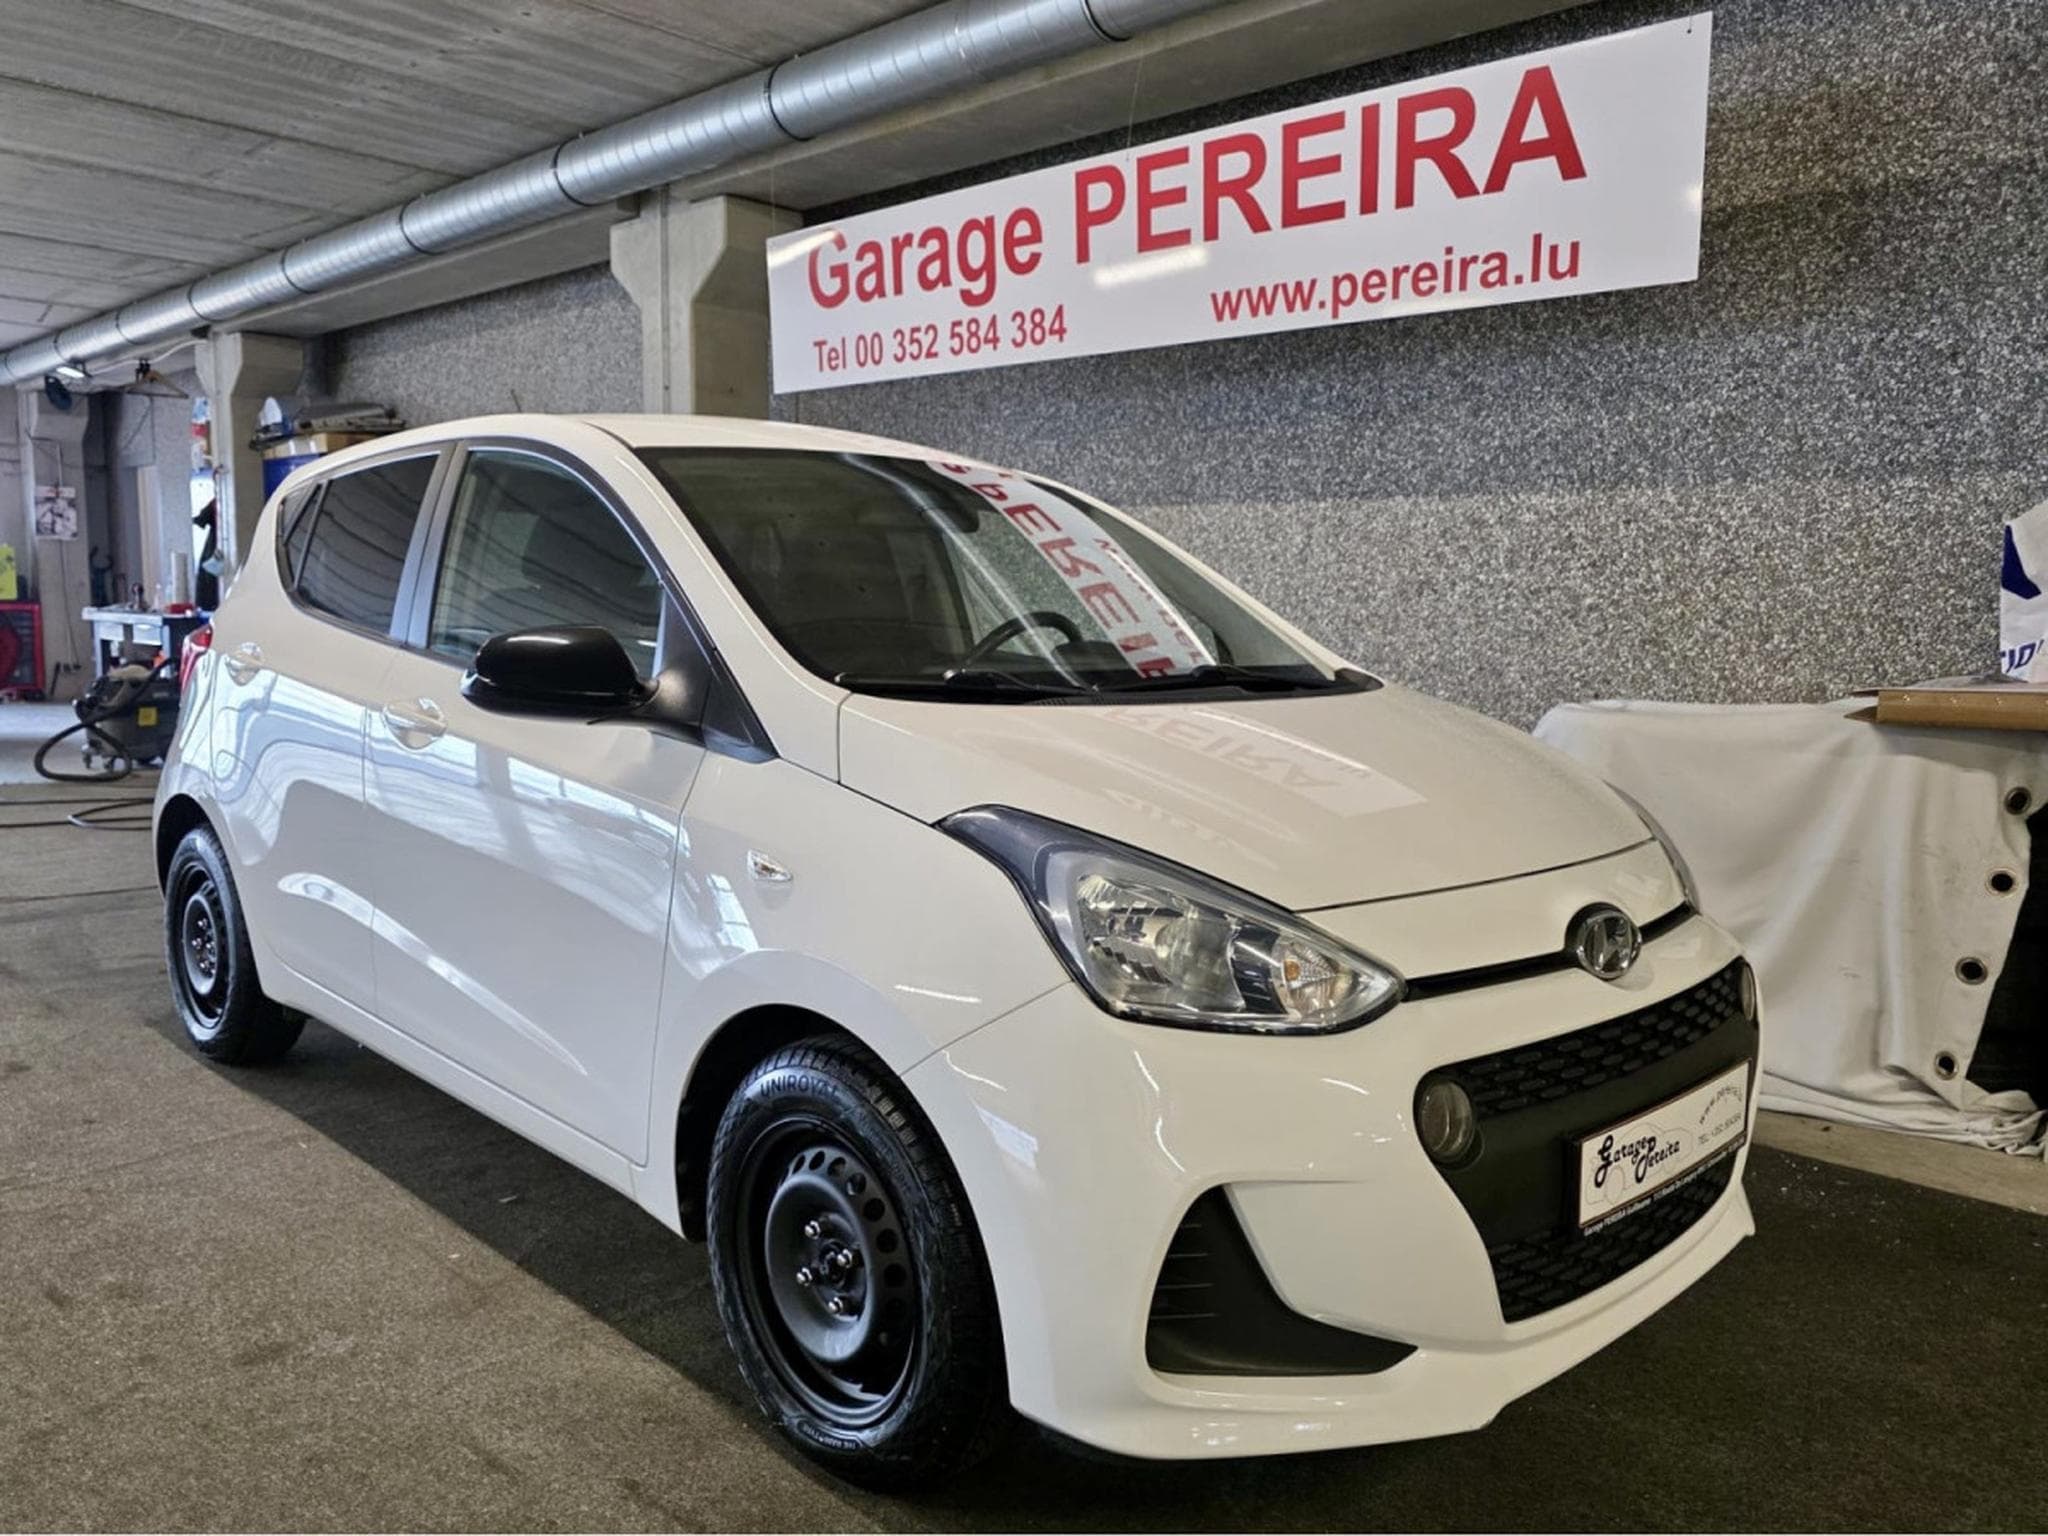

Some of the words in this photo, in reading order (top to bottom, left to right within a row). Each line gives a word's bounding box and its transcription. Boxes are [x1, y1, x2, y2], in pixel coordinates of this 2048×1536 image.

[808, 207, 1043, 308] Garage
[1075, 65, 1587, 264] PEREIRA
[1210, 233, 1580, 322] www.pereira.lu
[814, 338, 847, 372] Tel
[855, 332, 883, 368] 00
[893, 324, 938, 362] 352
[949, 314, 1000, 357] 584
[1011, 304, 1067, 349] 384
[760, 1074, 840, 1099] UNIROYAL
[1594, 1135, 1651, 1188] Garage
